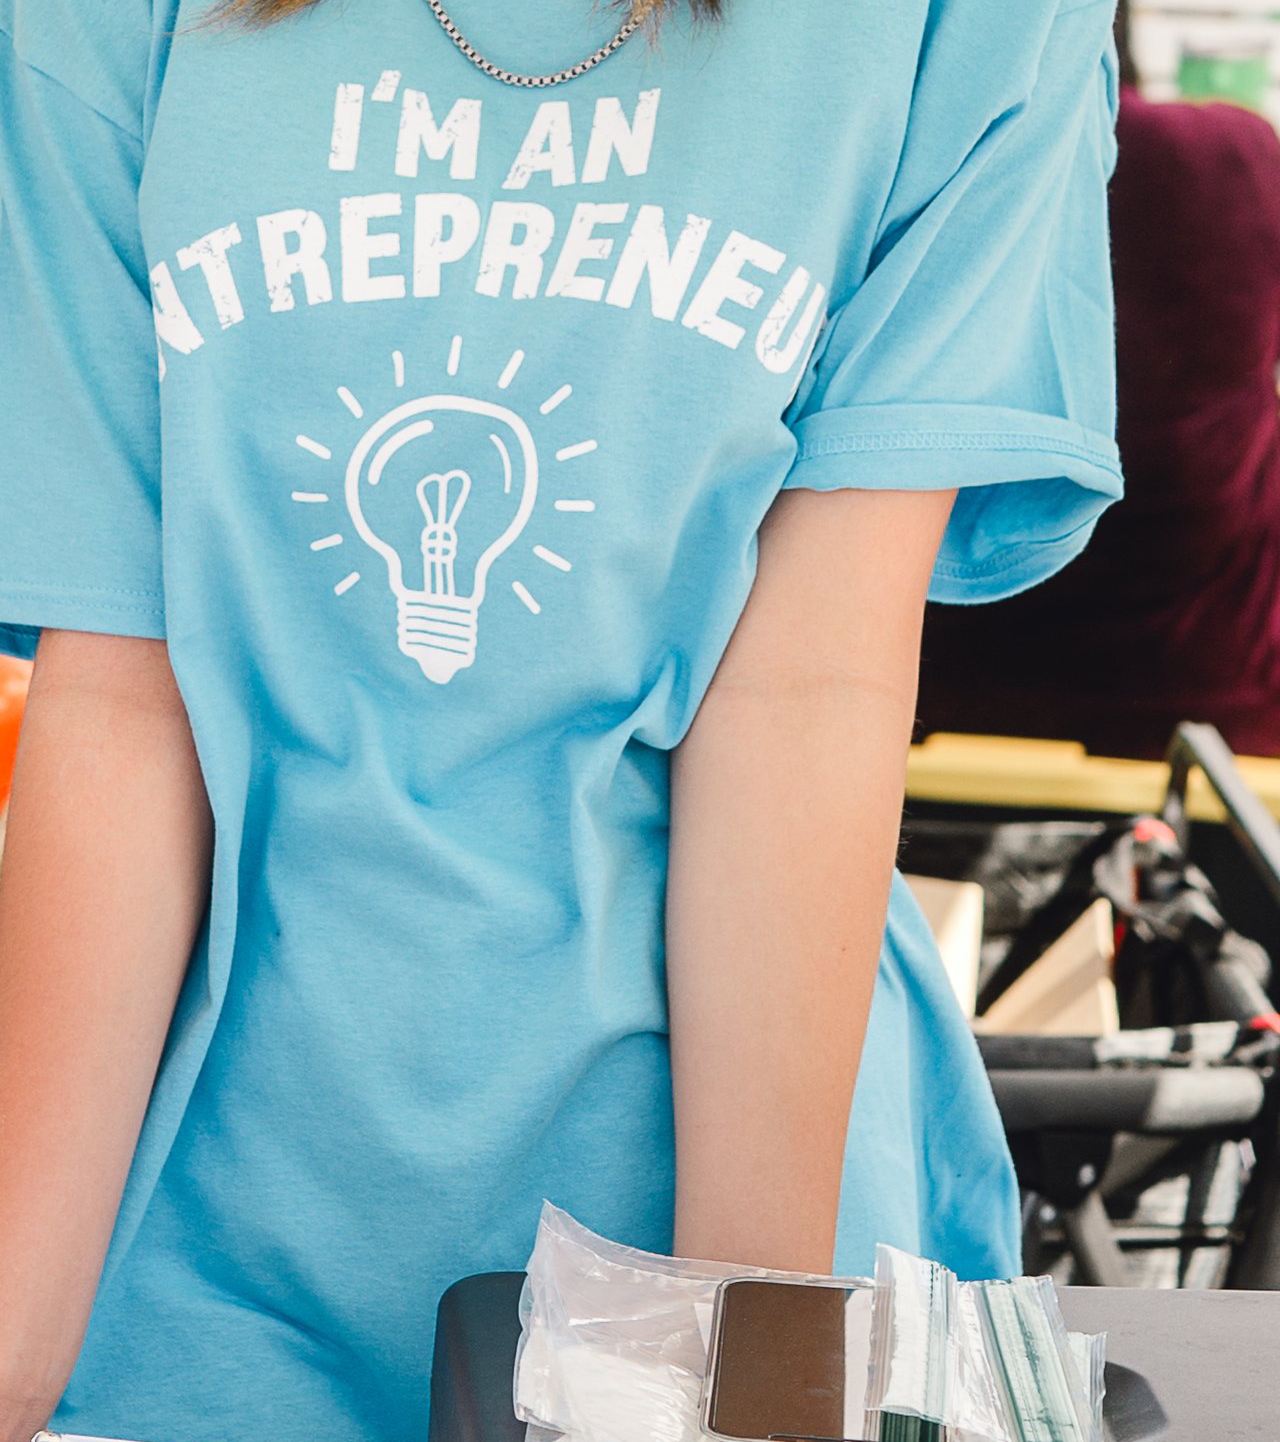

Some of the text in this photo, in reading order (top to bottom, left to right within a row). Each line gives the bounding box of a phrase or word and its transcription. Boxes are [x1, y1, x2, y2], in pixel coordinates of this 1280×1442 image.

[328, 69, 662, 190] I'M AN
[149, 191, 828, 392] NTREPRENEU
